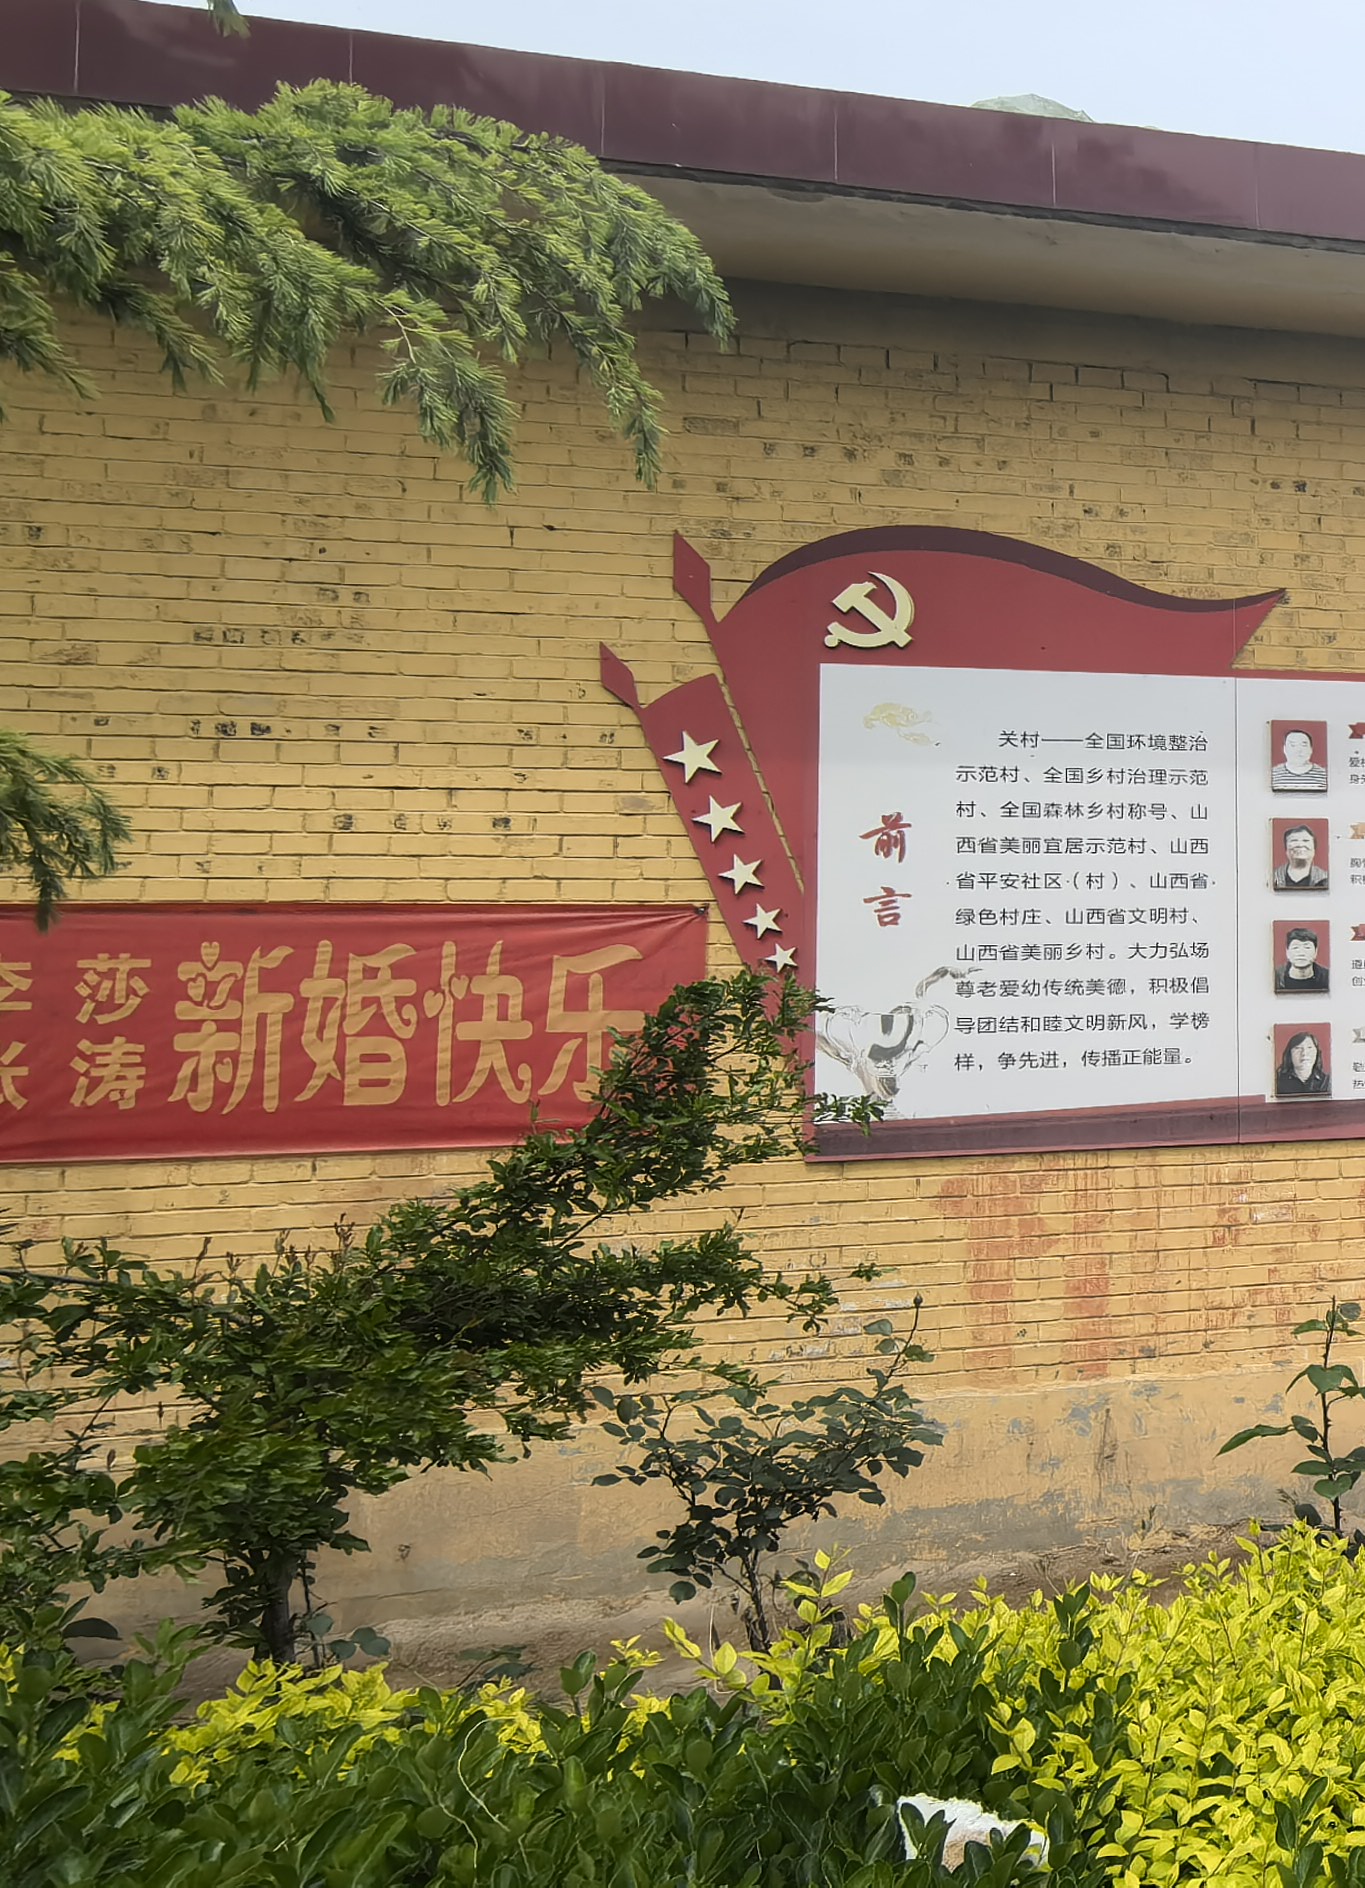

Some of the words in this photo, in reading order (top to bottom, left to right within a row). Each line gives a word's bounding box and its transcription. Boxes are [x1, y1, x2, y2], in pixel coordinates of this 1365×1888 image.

[956, 766, 1208, 786] 示范村、全国乡村治理示范
[859, 811, 912, 928] 前言
[956, 837, 1209, 856] 西省美丽宜居示范村、山西
[168, 940, 647, 1114] 新婚快乐
